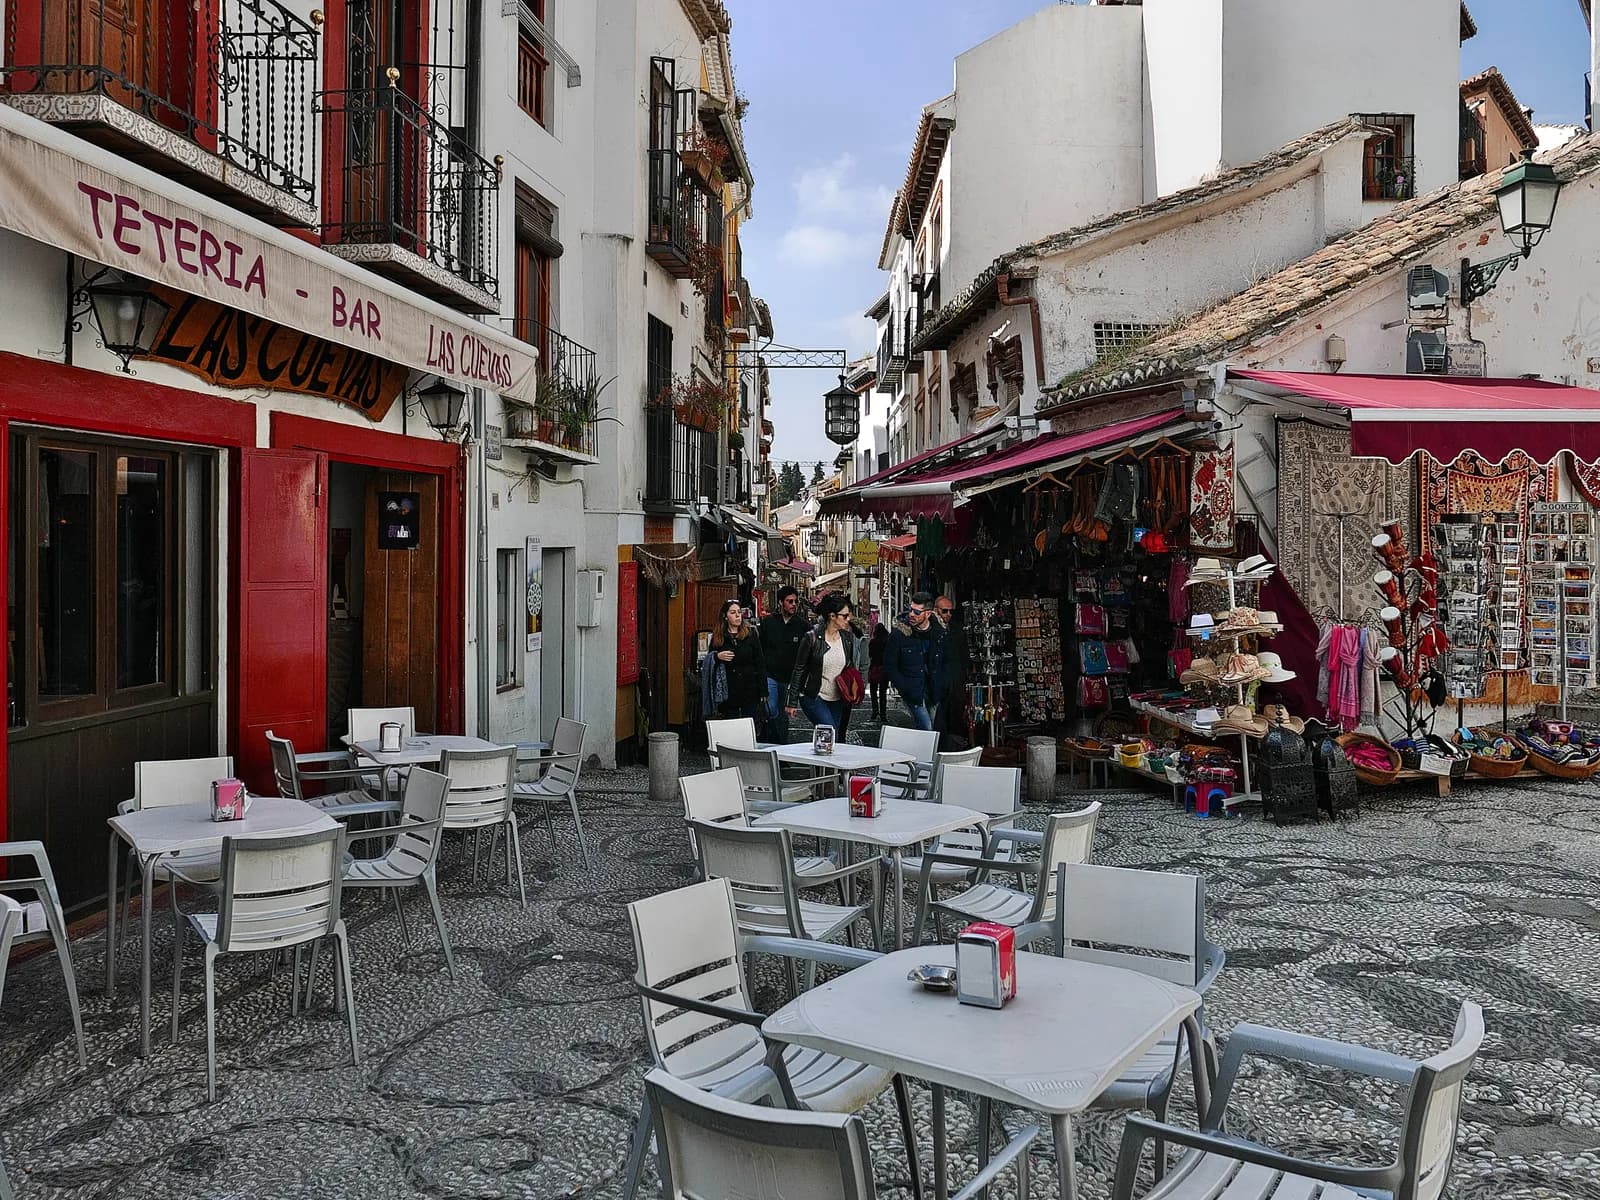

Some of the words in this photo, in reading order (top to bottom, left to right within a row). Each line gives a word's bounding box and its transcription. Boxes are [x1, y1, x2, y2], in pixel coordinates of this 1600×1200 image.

[78, 181, 267, 299] TETERIA
[332, 286, 382, 341] BAR
[154, 298, 258, 381] LAS
[257, 324, 387, 410] CUEVAS
[426, 324, 456, 375] LAS
[460, 334, 513, 389] CUEVAS
